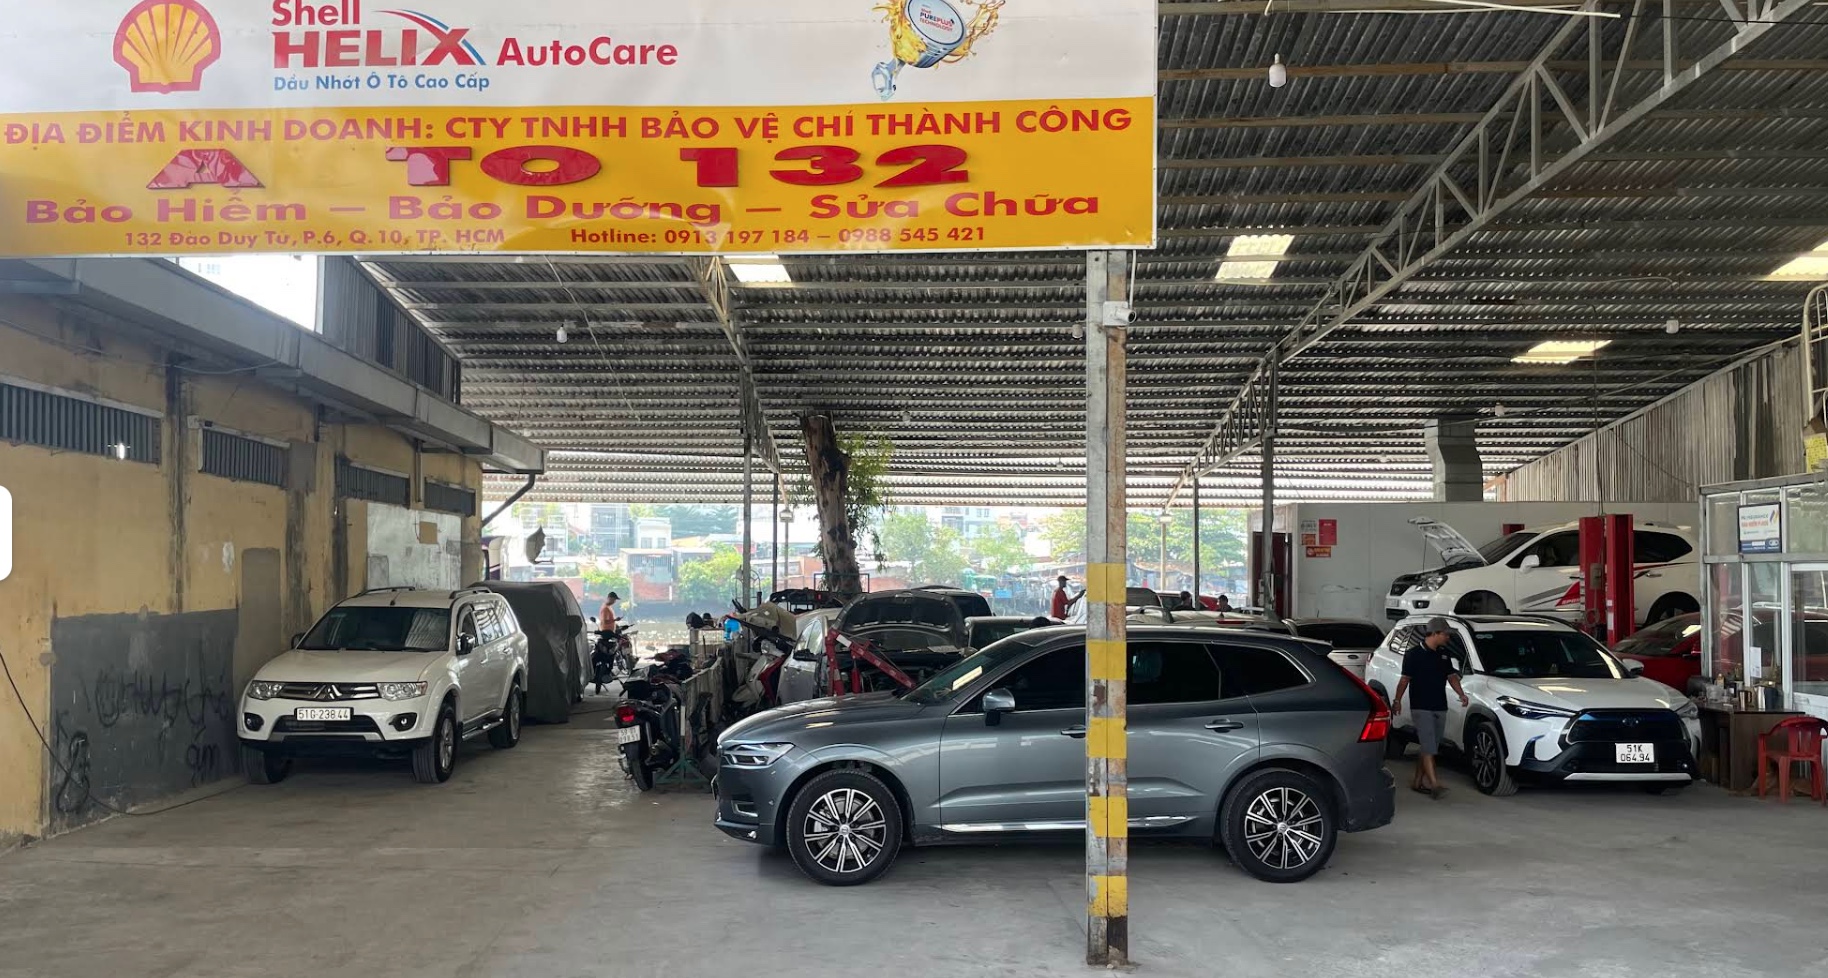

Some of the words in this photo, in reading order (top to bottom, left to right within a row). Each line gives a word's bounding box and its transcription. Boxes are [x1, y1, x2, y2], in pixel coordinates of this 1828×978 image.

[271, 0, 360, 27] Shell
[272, 28, 476, 68] HELIX
[496, 36, 678, 66] AutoCare
[316, 75, 361, 89] Nhớt
[367, 72, 380, 89] Ô
[388, 73, 408, 88] Tô
[415, 74, 449, 89] Cao
[455, 71, 489, 92] Cấp
[4, 123, 65, 150] ĐỊA
[77, 111, 166, 143] ĐIỂM
[179, 120, 272, 142] KINH
[284, 117, 433, 140] DOANH:
[446, 117, 512, 138] CTY
[521, 116, 626, 138] TNHH
[641, 111, 720, 138] BẢO
[734, 113, 779, 143] VỆ
[793, 110, 854, 137] CHÍ
[866, 108, 1000, 135] THÀNH
[1016, 105, 1131, 132] CÔNG
[146, 148, 266, 190] A
[386, 145, 602, 186] TO
[679, 145, 969, 188] 132
[26, 199, 133, 223] Bảo
[157, 188, 306, 223] Hiểm
[389, 195, 502, 220] Bảo
[526, 195, 721, 227] Dưỡng
[809, 193, 919, 219] Sửa
[945, 191, 1098, 217] Chữa
[125, 232, 162, 246] 132
[169, 230, 211, 246] Đào
[218, 231, 258, 248] Duy
[303, 230, 342, 246] P.6,
[455, 229, 505, 244] HCM
[571, 229, 656, 243] Hotline:
[664, 229, 717, 244] 0913
[726, 229, 763, 244] 197
[772, 229, 809, 244] 184
[838, 228, 891, 243] 0988
[900, 227, 939, 242] 545
[946, 226, 984, 241] 421
[1626, 744, 1643, 753] 51K
